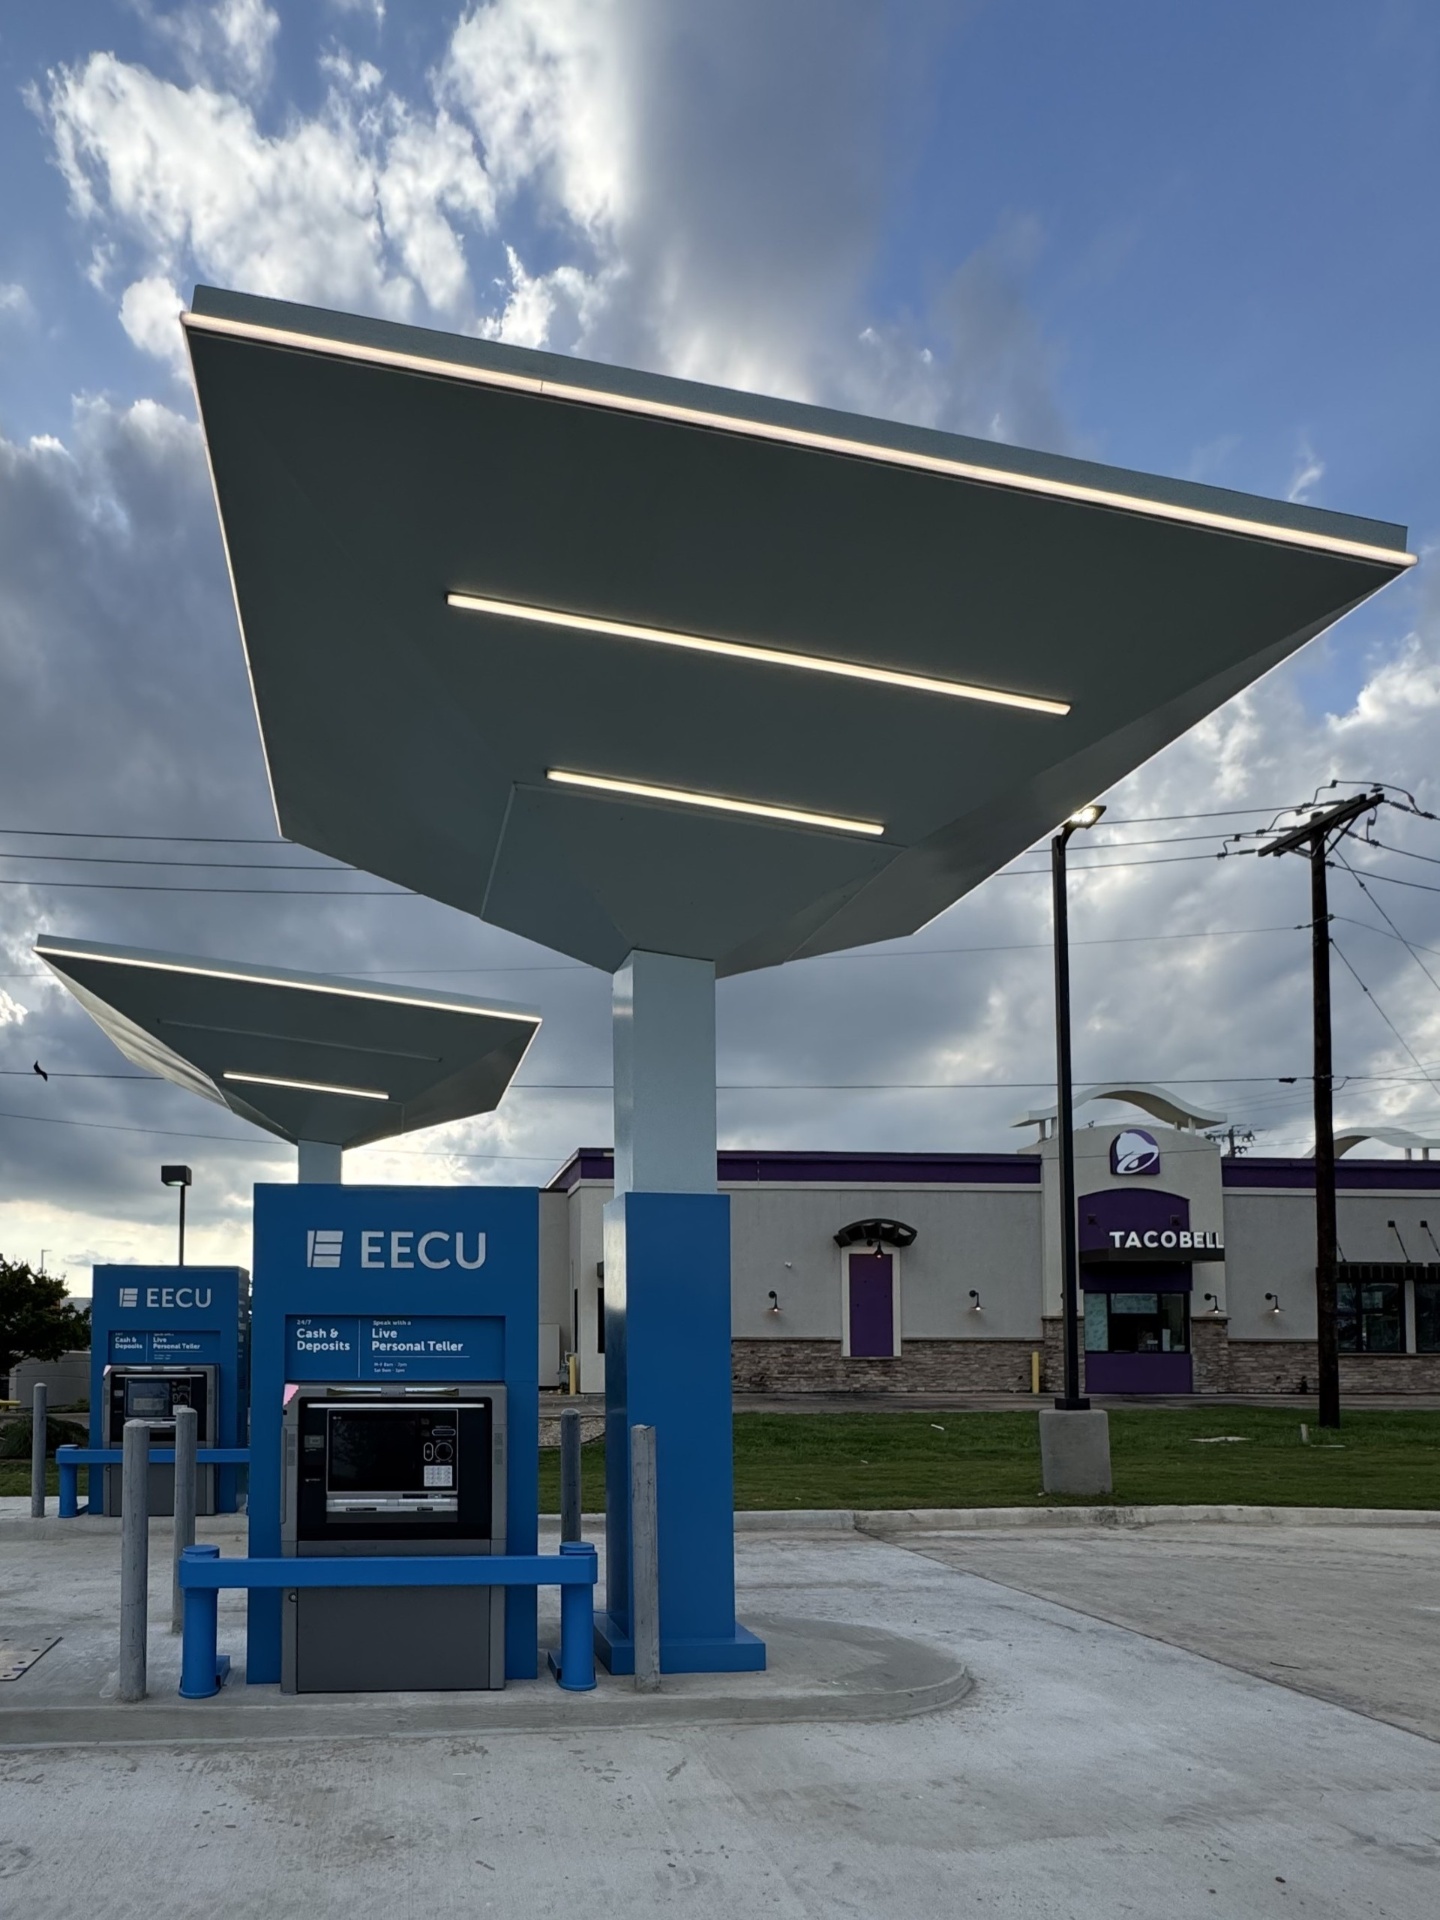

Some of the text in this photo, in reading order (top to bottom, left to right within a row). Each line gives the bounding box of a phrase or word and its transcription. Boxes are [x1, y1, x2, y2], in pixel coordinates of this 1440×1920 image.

[1109, 1230, 1225, 1249] TACO BELL
[360, 1230, 487, 1270] EECU
[146, 1288, 212, 1308] EECU
[296, 1328, 339, 1338] Cash &
[371, 1328, 398, 1338] Live
[296, 1341, 351, 1353] Deposits
[371, 1341, 464, 1352] Personal Teller
